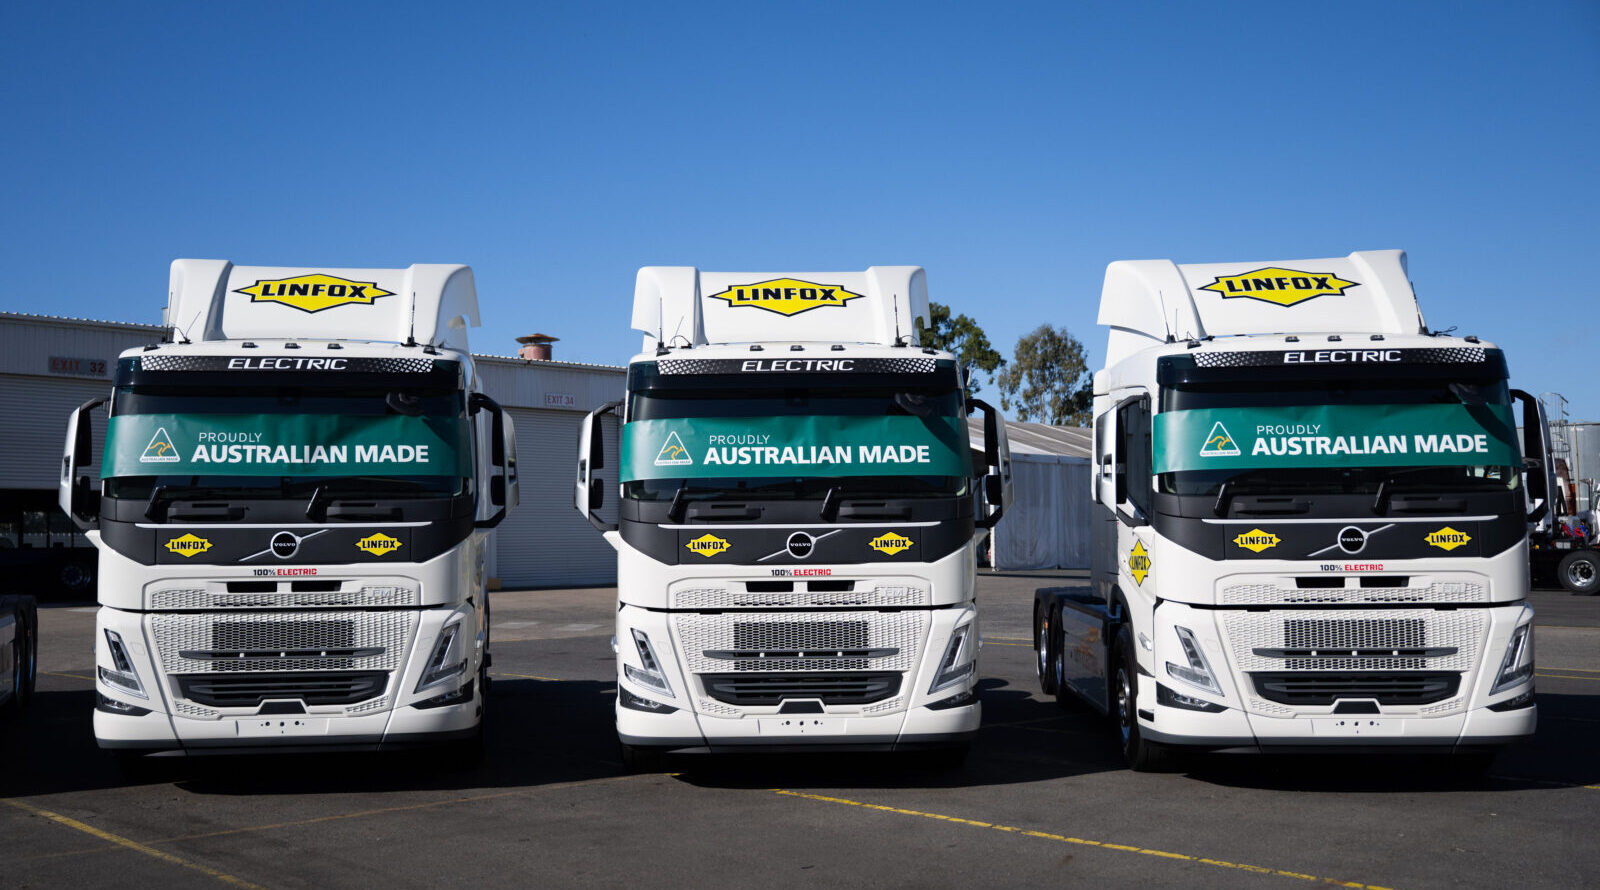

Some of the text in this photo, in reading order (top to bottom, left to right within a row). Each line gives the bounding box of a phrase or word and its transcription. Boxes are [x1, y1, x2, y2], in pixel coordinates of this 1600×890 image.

[1225, 276, 1335, 293] LINFOX
[261, 283, 369, 298] LINFOX
[736, 287, 838, 301] LINFOX
[1283, 350, 1402, 364] ELECTRIC
[52, 359, 105, 373] EXIT 32
[227, 357, 348, 370] ELECTRIC
[741, 359, 854, 372] ELECTRIC
[547, 394, 563, 404] EXIT
[1256, 424, 1321, 435] PROUDLY
[199, 432, 262, 443] PROUDLY
[709, 434, 770, 445] PROUDLY
[1251, 434, 1489, 456] AUSTRALIAN MADE
[190, 444, 429, 463] AUSTRALIAN MADE
[703, 445, 931, 465] AUSTRALIAN MADE
[1239, 536, 1274, 545] LINFOX
[1430, 533, 1465, 543] LINFOX
[171, 540, 206, 550] LINFOX
[361, 540, 397, 549] LINFOX
[692, 541, 725, 550] LINFOX
[875, 539, 908, 549] LINFOX
[253, 568, 318, 576] 100% ELECTRIC
[793, 568, 832, 576] ELECTRIC
[1344, 563, 1384, 571] ELECTRIC
